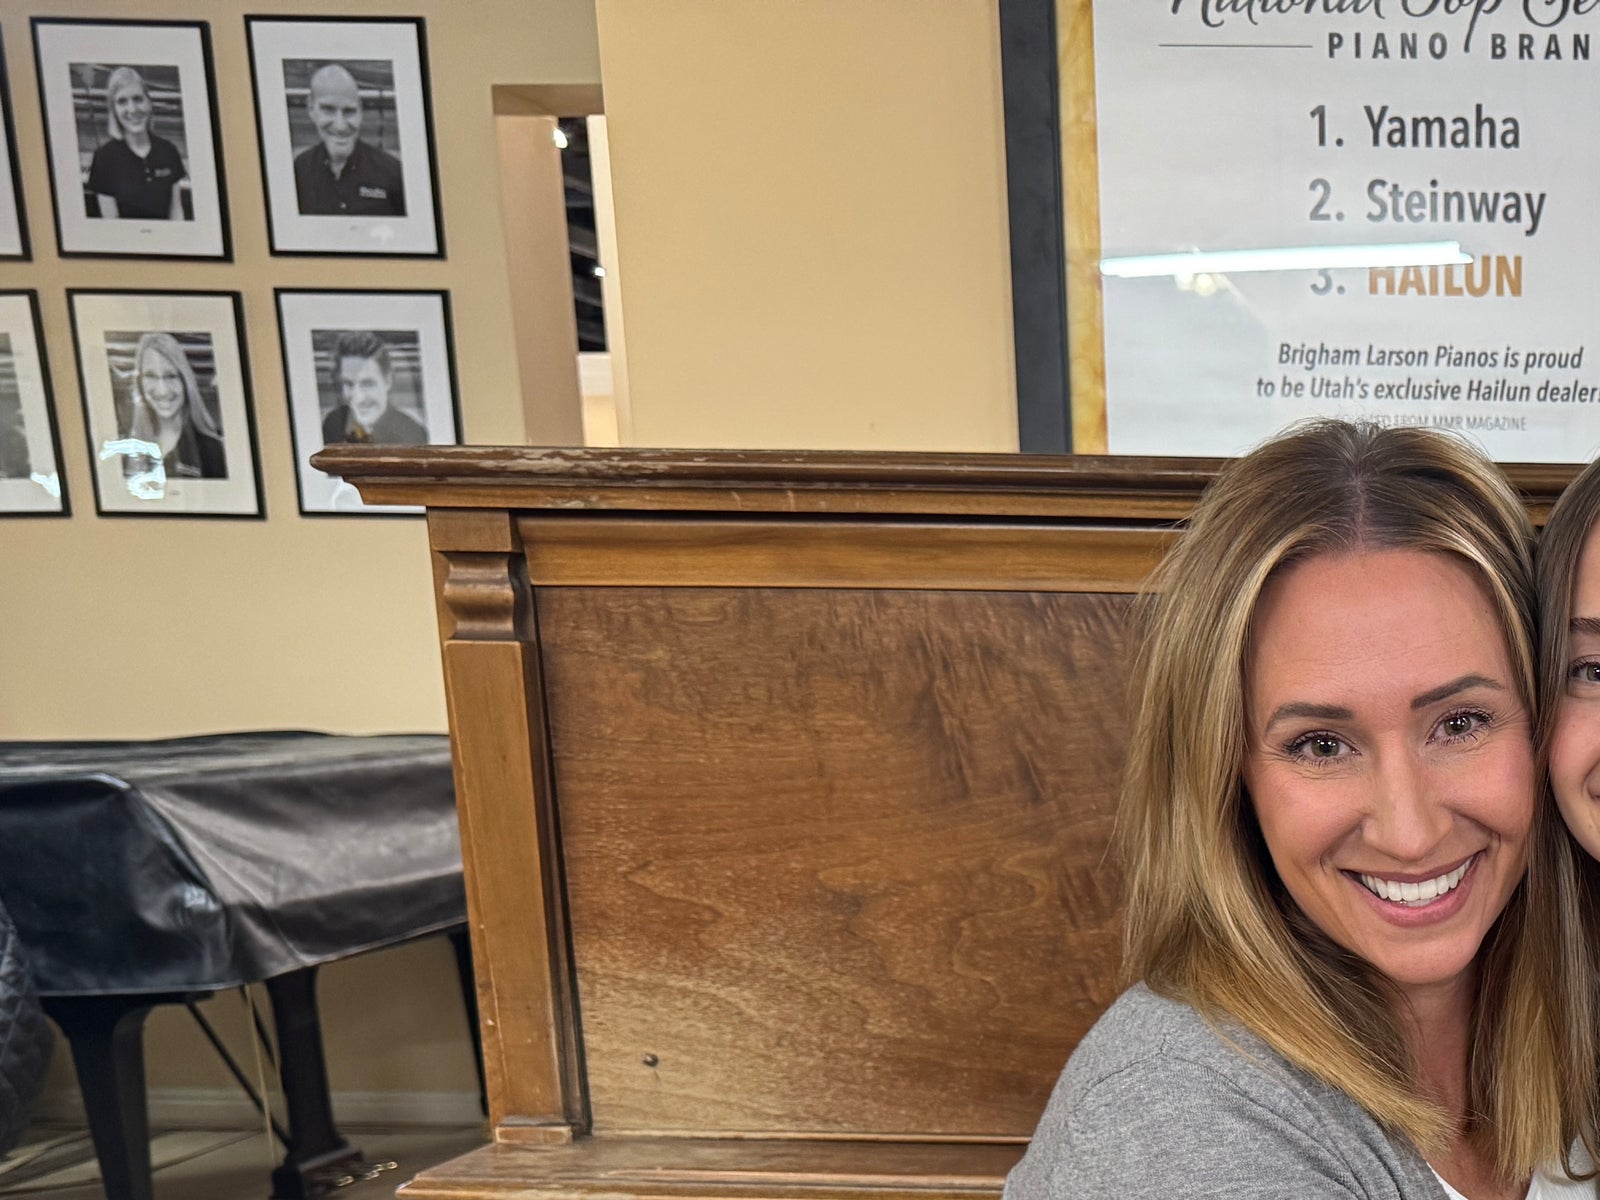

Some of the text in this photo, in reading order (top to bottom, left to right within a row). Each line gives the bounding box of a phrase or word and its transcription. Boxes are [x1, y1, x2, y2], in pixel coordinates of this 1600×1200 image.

[1328, 32, 1448, 60] PIANO
[1309, 103, 1520, 149] 1. Yamaha
[1309, 178, 1547, 237] 2. Steinway
[1368, 254, 1523, 298] HAILUN
[1278, 343, 1585, 375] Brigham Larson Pianos is proud
[1256, 377, 1276, 398] to
[1280, 376, 1305, 399] be
[1310, 376, 1370, 399] Utah's
[1374, 377, 1462, 401] exclusive
[1467, 379, 1531, 402] Hailun
[1466, 415, 1528, 431] MAGAZINE
